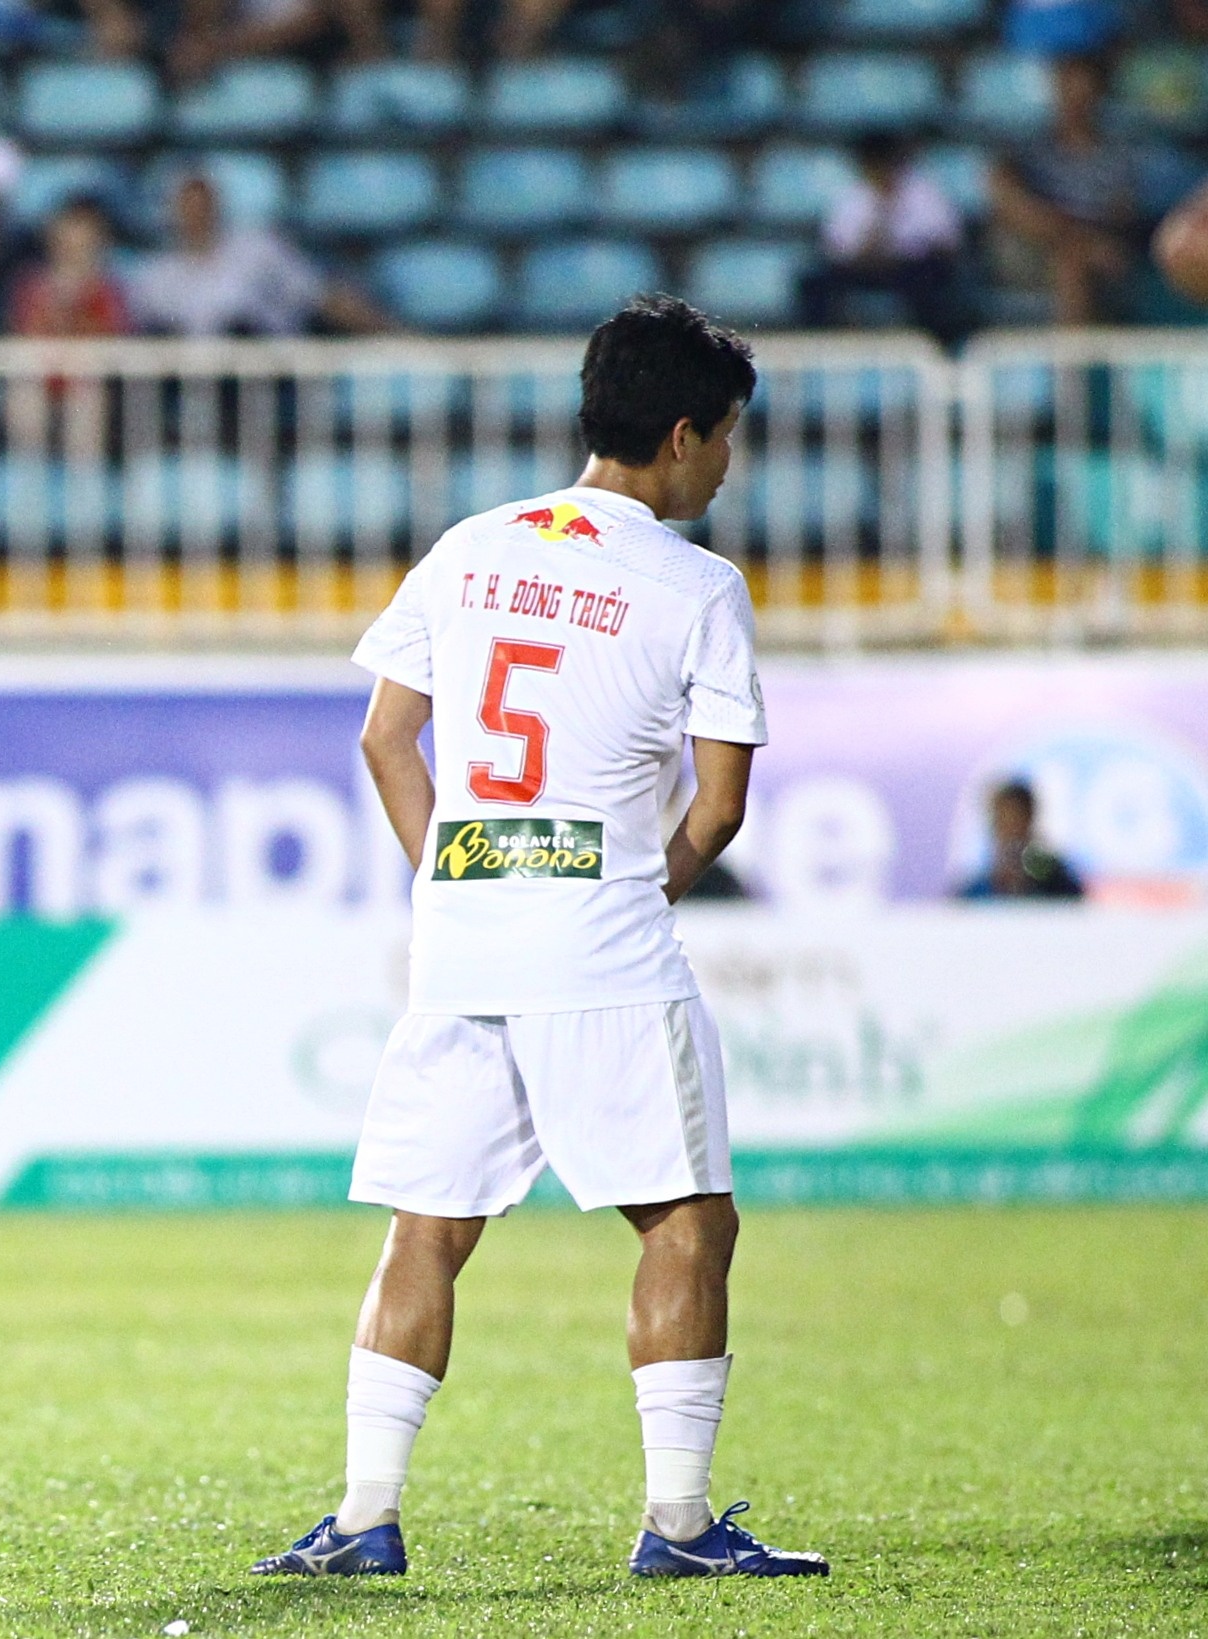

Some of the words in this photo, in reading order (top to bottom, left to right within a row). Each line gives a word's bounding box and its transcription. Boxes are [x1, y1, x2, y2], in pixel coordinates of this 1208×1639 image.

[461, 573, 474, 608] T.
[484, 574, 500, 610] H.
[509, 574, 563, 620] ĐÔNG
[466, 637, 565, 807] 5
[498, 835, 575, 848] BOLAVEN
